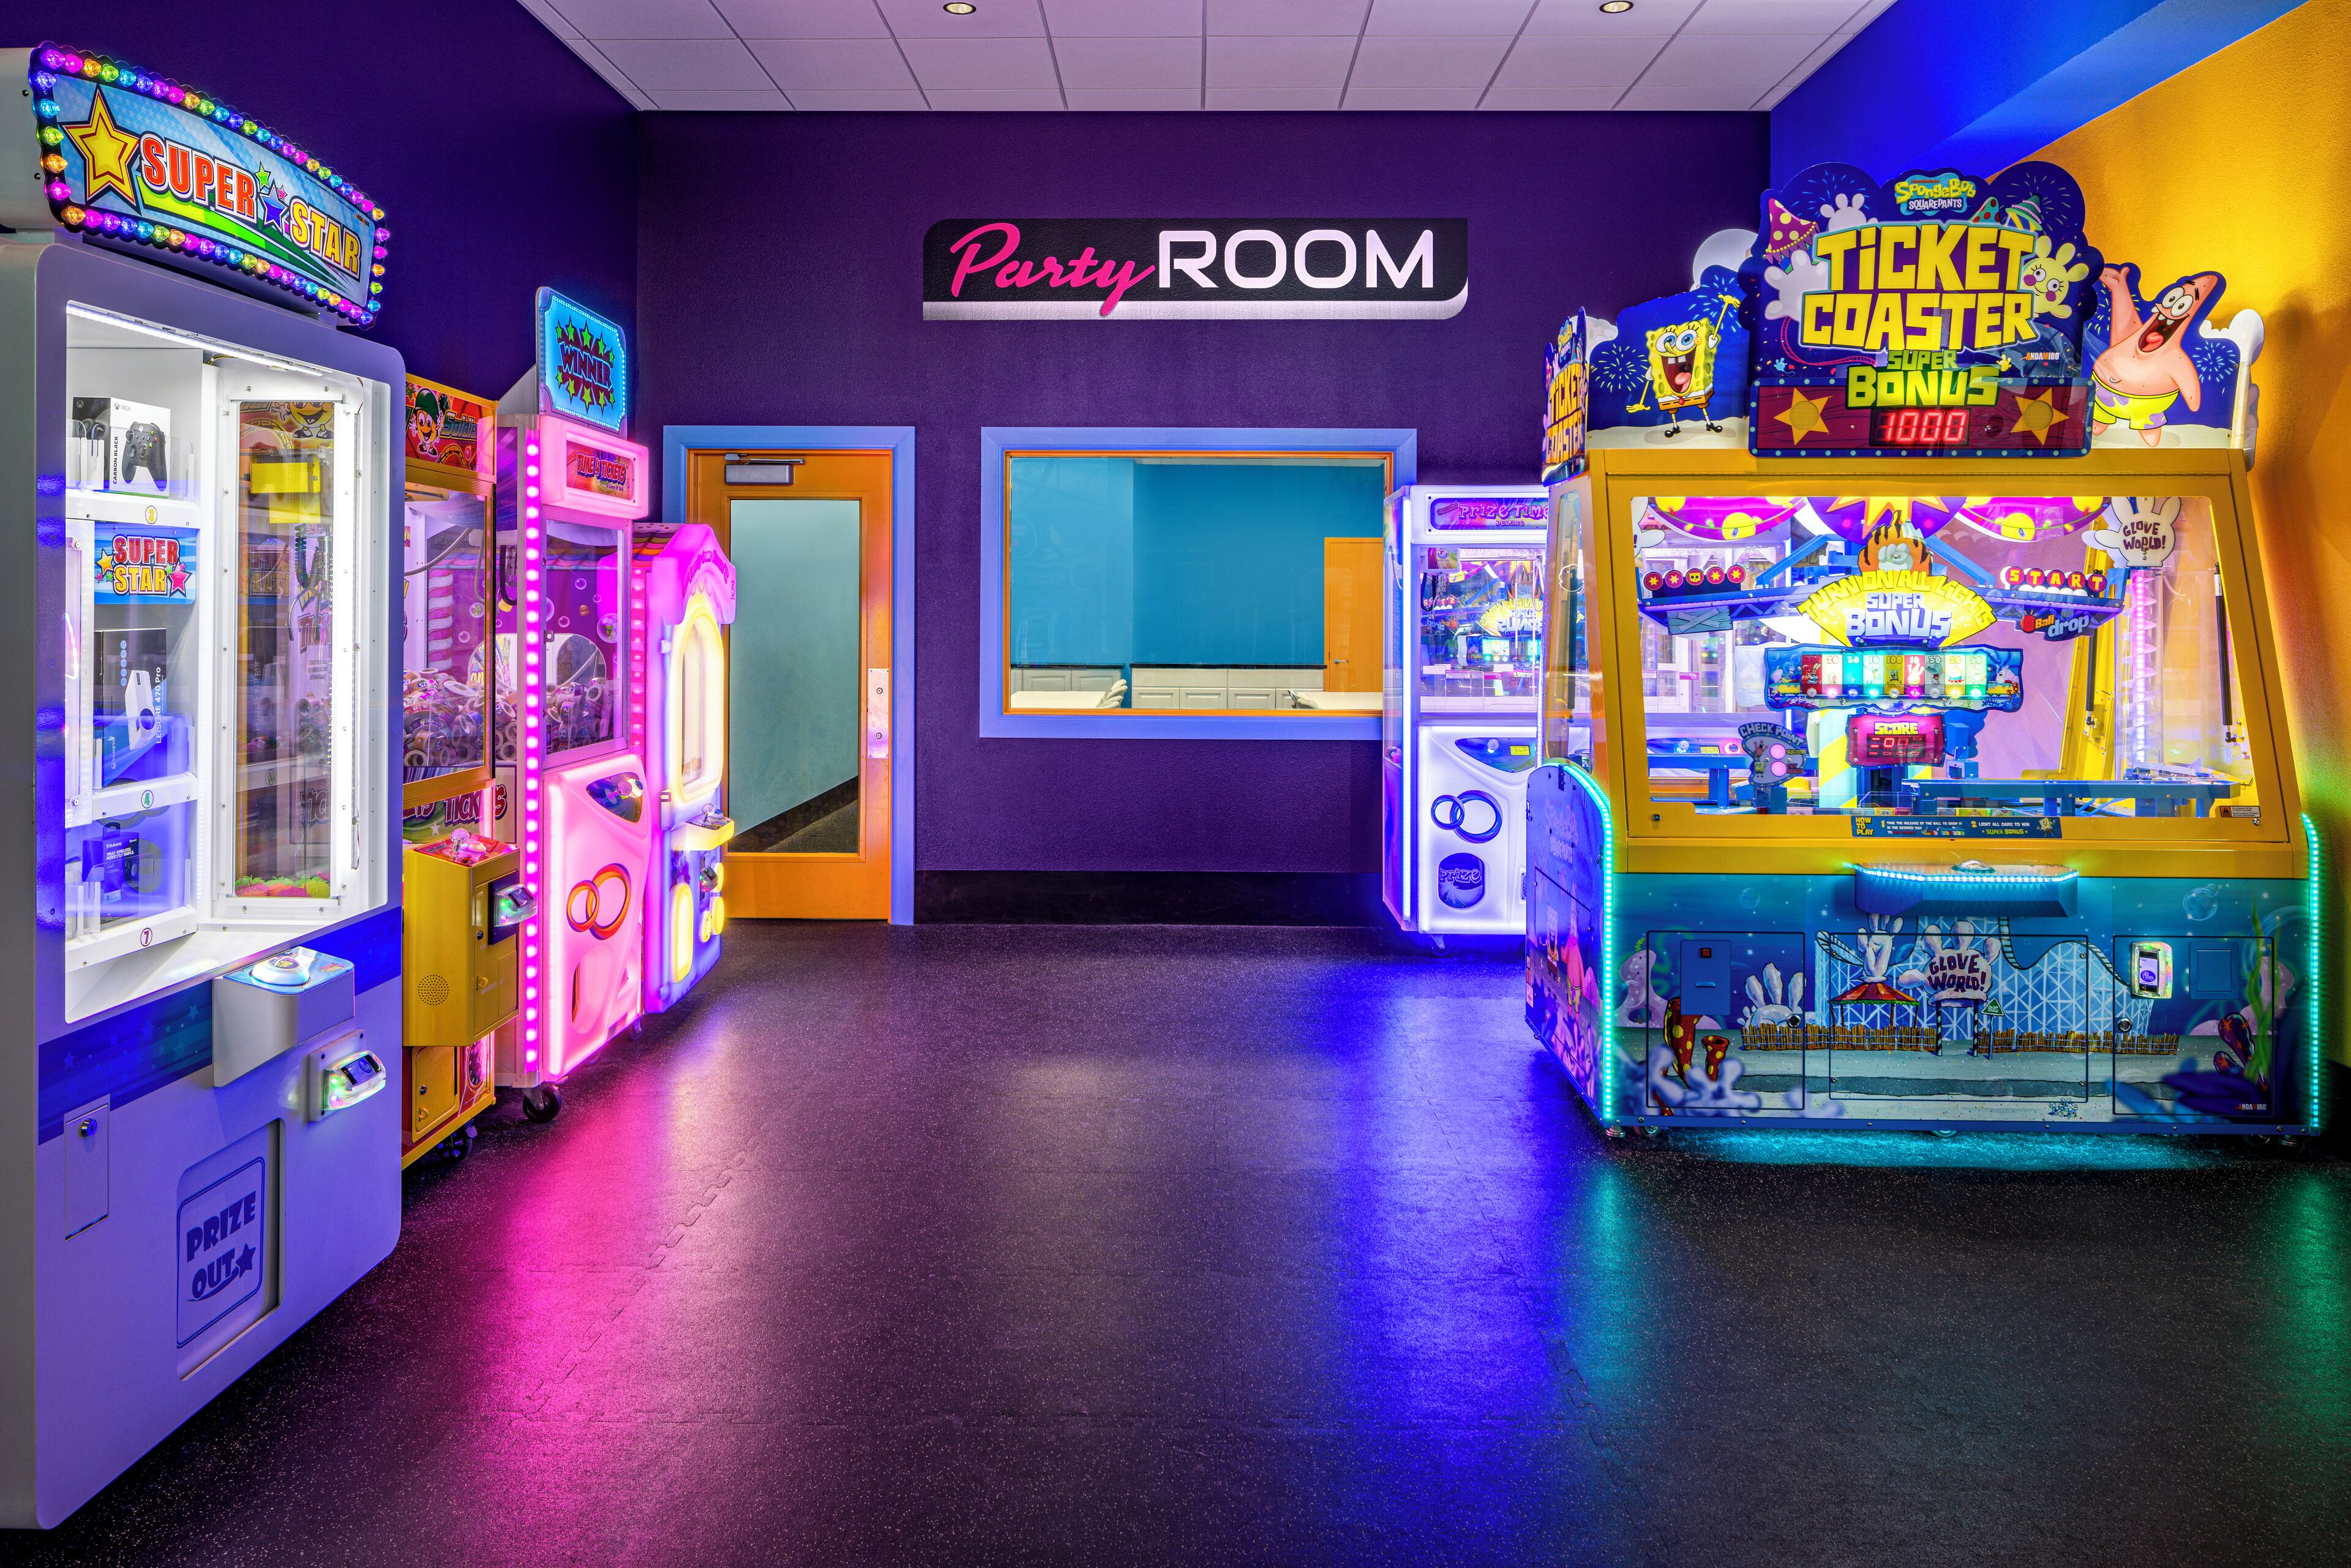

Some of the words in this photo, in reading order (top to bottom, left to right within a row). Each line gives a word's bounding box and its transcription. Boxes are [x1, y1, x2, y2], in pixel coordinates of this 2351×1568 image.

[1894, 178, 1976, 204] SpongeBob
[141, 135, 256, 221] SUPER
[290, 198, 362, 277] STAR
[1909, 198, 1962, 210] SQUAREPANTS
[950, 222, 1155, 317] Party
[1159, 230, 1433, 289] ROOM
[1803, 293, 2038, 350] COASTER
[559, 342, 612, 391] WINNER
[1888, 350, 1959, 370] SUPER
[2025, 351, 2061, 361] ANDAMIRO
[1848, 366, 2001, 407] BONUS
[441, 411, 478, 439] Soldie
[1546, 409, 1584, 463] COASTER
[1884, 411, 1968, 442] 1000
[577, 453, 594, 475] TIME
[595, 457, 600, 476] 4
[601, 460, 626, 483] TICKETS
[149, 509, 154, 522] 3
[2123, 520, 2160, 537] GLOVE
[114, 536, 179, 565] SUPER
[2123, 535, 2166, 552] WORLD!
[114, 565, 167, 593] STAR
[2009, 569, 2103, 590] START
[1796, 576, 1861, 619] TURN
[1862, 570, 1894, 590] ON
[1898, 570, 1931, 591] ALL
[1867, 592, 1925, 610] SUPER
[1846, 609, 1952, 637] BONUS
[2035, 614, 2055, 629] Ball
[2048, 615, 2090, 637] drop
[1847, 656, 1859, 664] 30
[1886, 656, 1903, 664] 100
[1910, 656, 1920, 664] 10
[1928, 656, 1941, 664] 30
[1739, 723, 1774, 737] CHECK
[1874, 722, 1919, 735] SCORE
[443, 784, 506, 827] TICKS
[142, 931, 149, 943] 7
[1929, 953, 1980, 975] GLOVE
[1927, 971, 1987, 992] WORLD!
[186, 1190, 256, 1262] PRIZE
[192, 1247, 236, 1299] OUT
